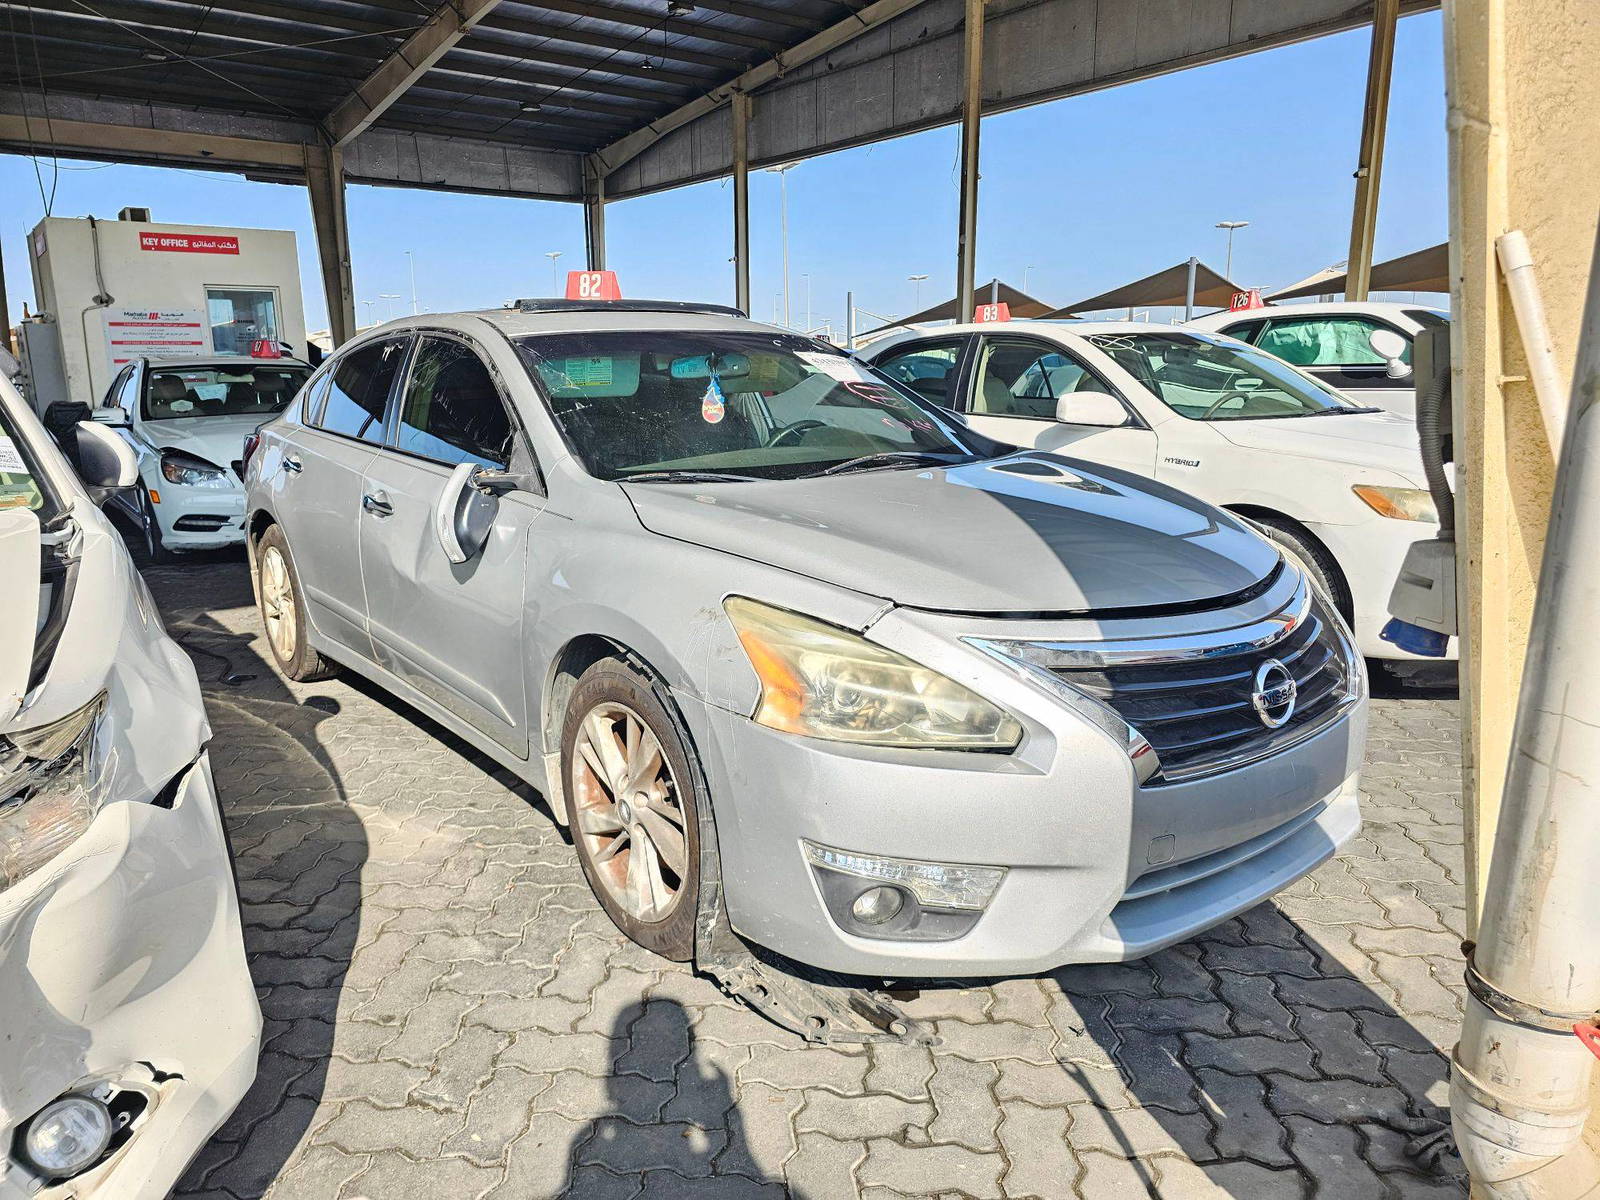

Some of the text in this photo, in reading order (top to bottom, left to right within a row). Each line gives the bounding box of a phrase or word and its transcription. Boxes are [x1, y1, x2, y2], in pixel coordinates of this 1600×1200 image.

[142, 237, 189, 248] KEY OFFICE
[217, 241, 237, 249] مكتب
[579, 273, 602, 297] 82
[1233, 292, 1250, 309] 126
[983, 305, 999, 322] 83
[1163, 457, 1195, 467] HYBRID
